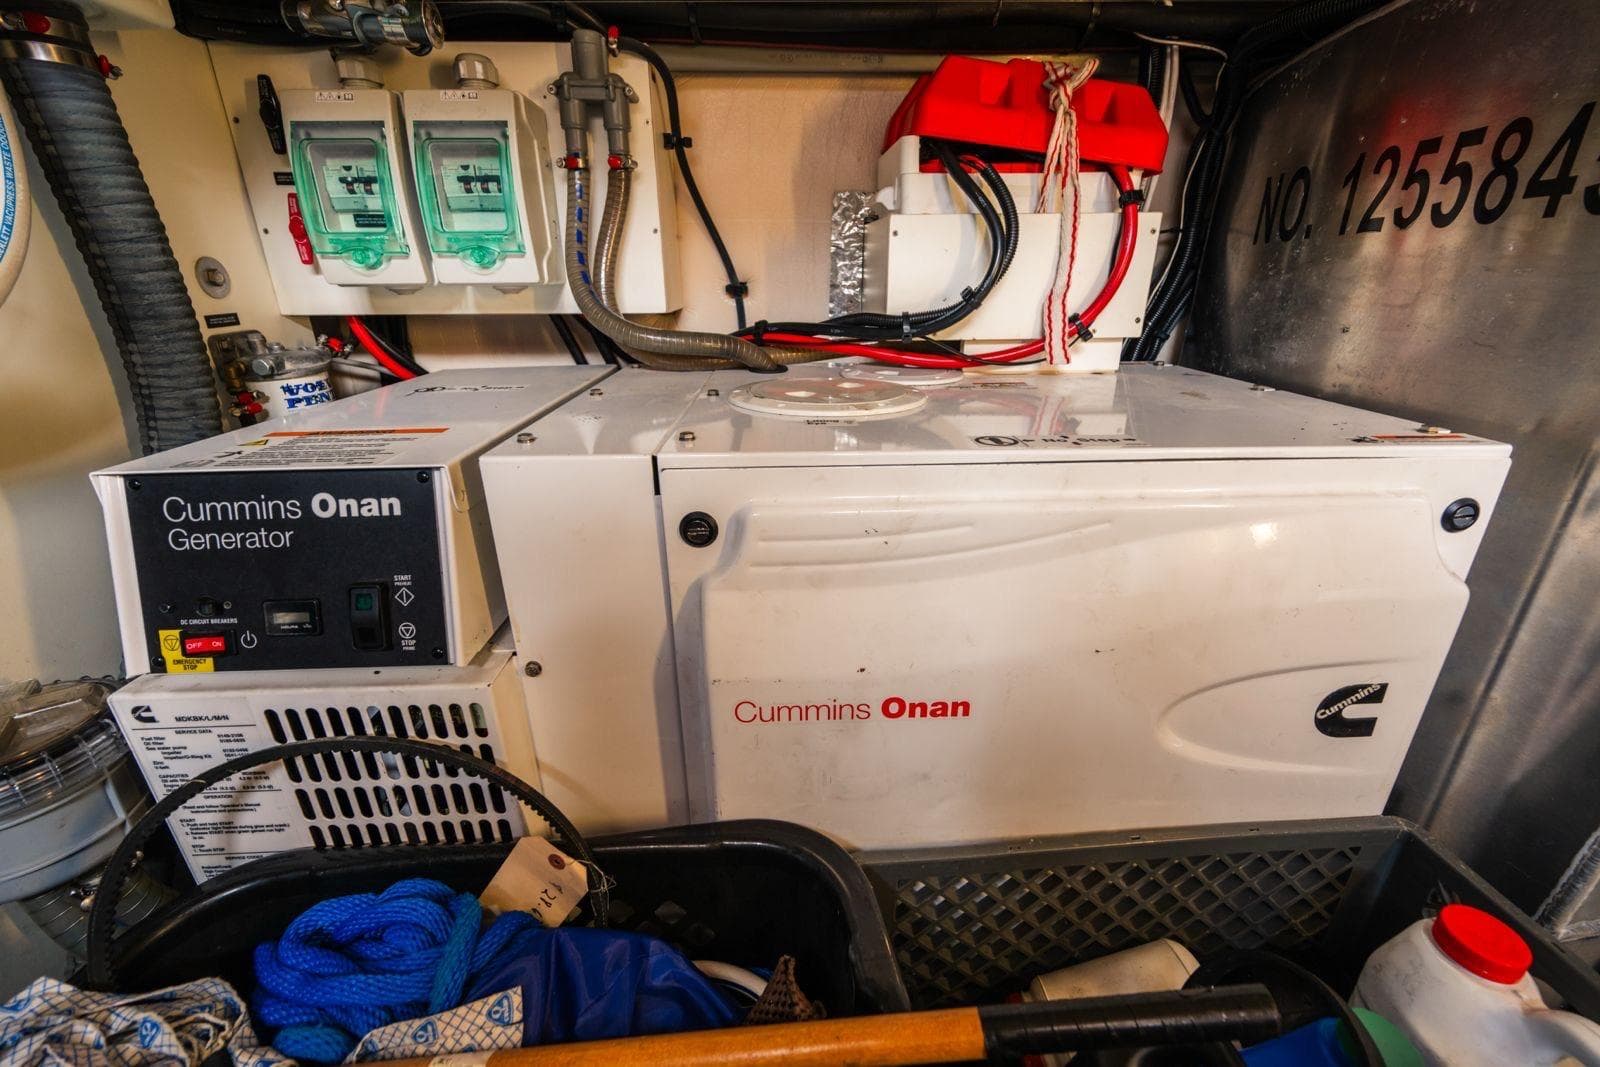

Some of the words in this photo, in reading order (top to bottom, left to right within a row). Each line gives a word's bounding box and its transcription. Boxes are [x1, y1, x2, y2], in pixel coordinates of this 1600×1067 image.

[1252, 166, 1313, 245] NO.
[162, 494, 302, 523] Cummins
[311, 492, 402, 519] Onan
[168, 527, 294, 551] Generator
[734, 699, 871, 723] Cummins
[881, 696, 971, 719] Onan
[1316, 684, 1380, 719] Cummins
